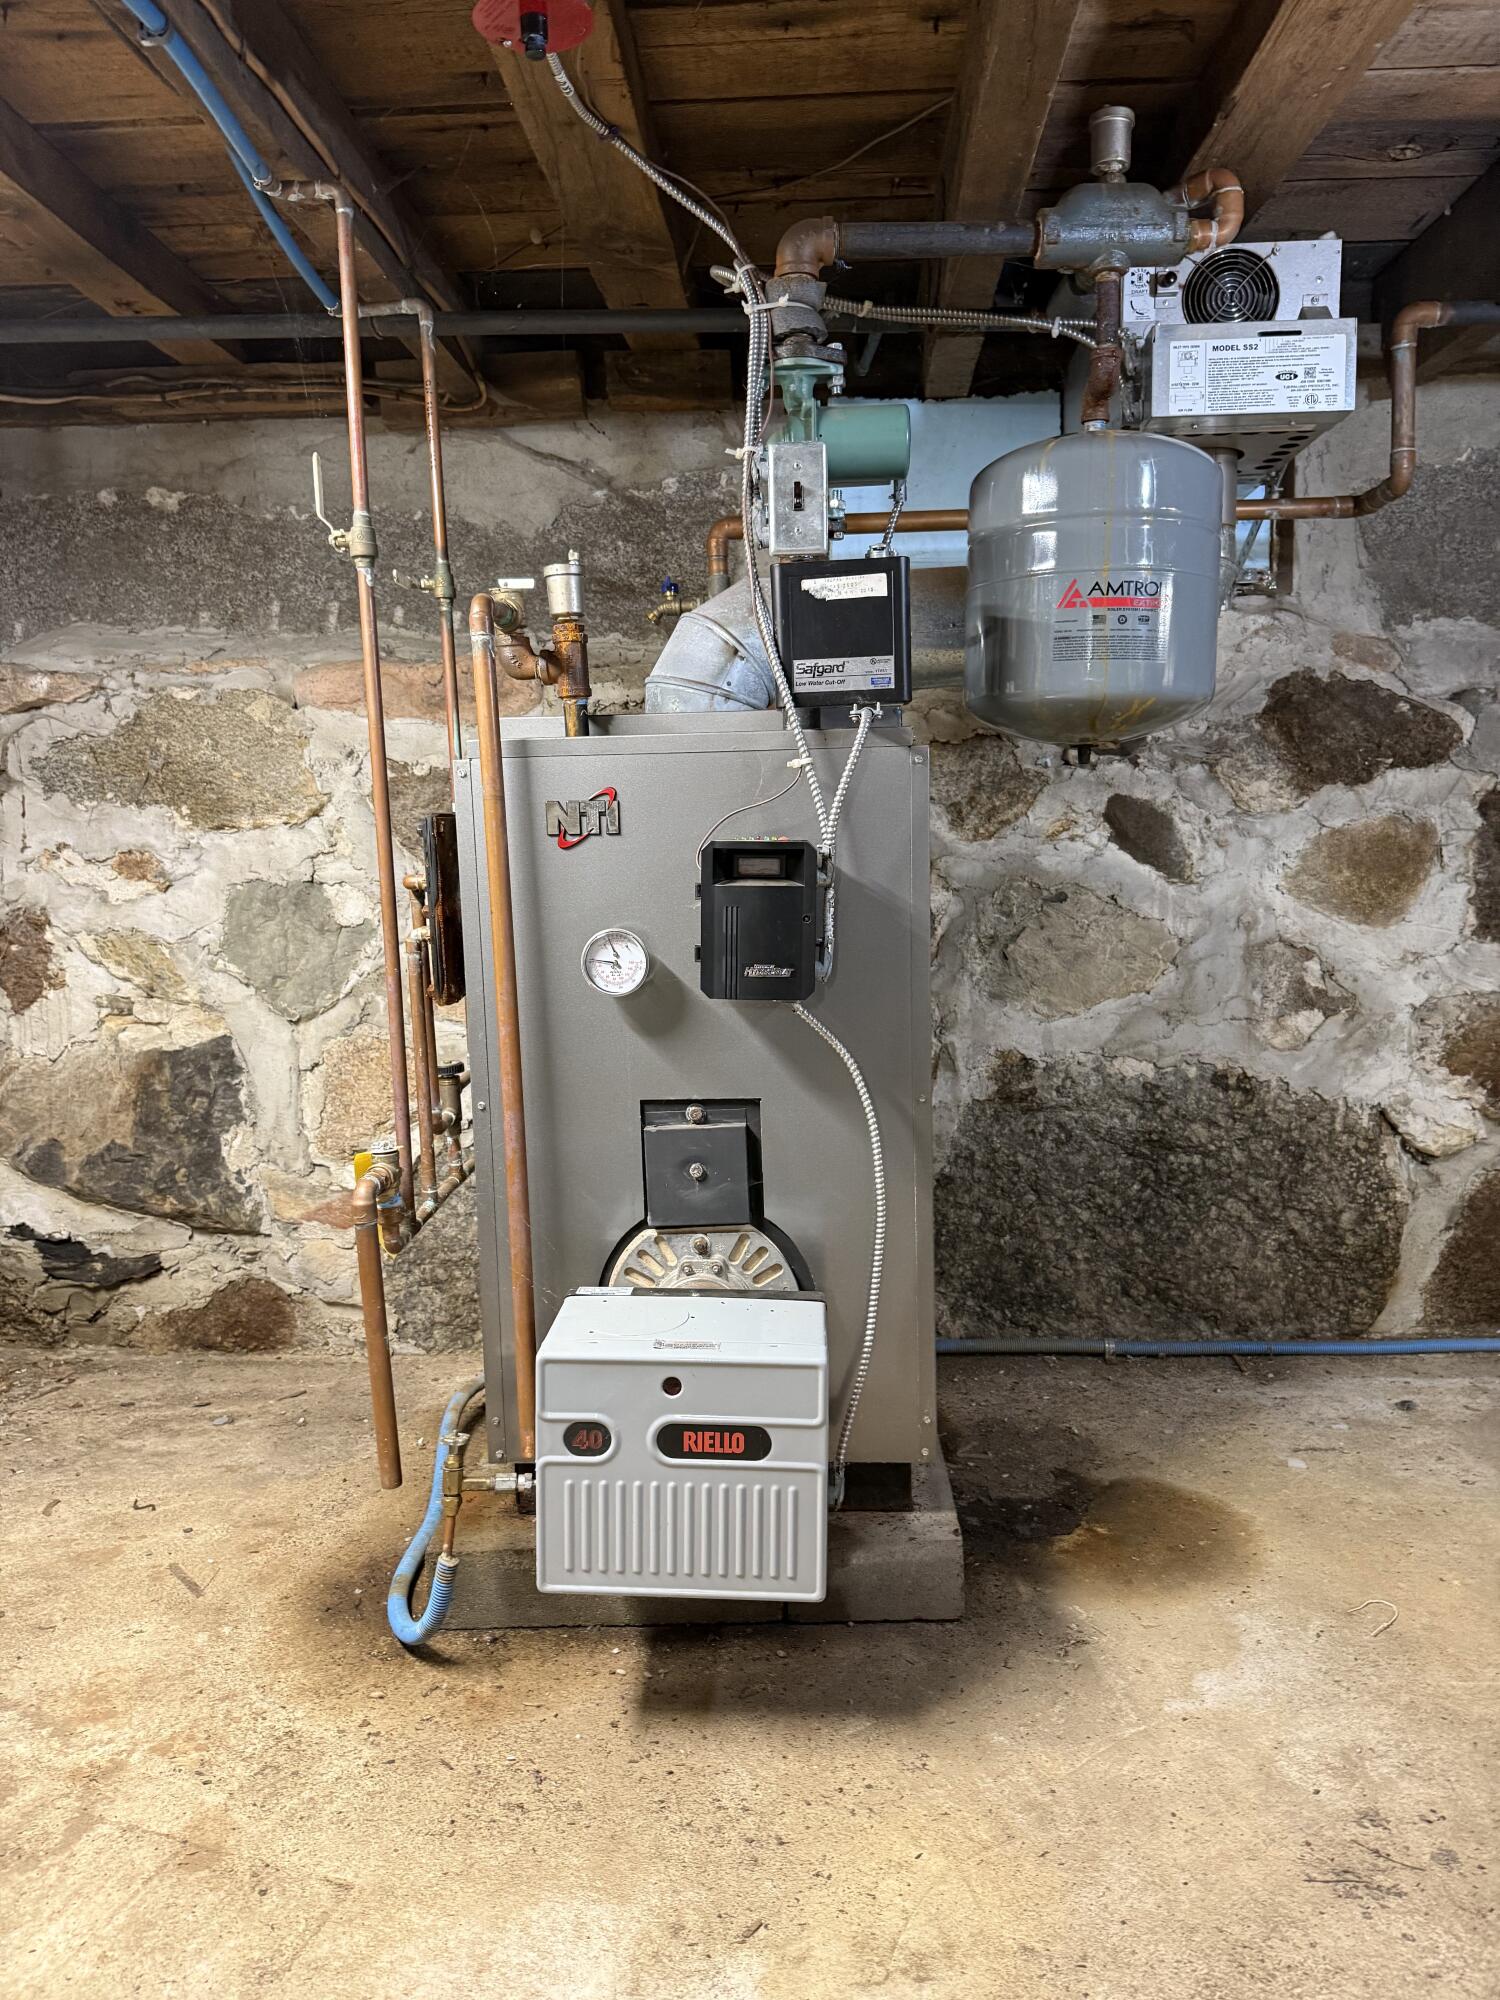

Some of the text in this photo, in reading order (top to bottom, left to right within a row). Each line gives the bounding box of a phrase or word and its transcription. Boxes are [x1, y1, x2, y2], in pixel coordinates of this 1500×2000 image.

[1212, 343, 1259, 352] MODEL SS2
[796, 661, 845, 678] Safgard
[546, 799, 621, 836] NTI
[571, 1429, 603, 1450] 40
[683, 1431, 745, 1454] RIELLO
